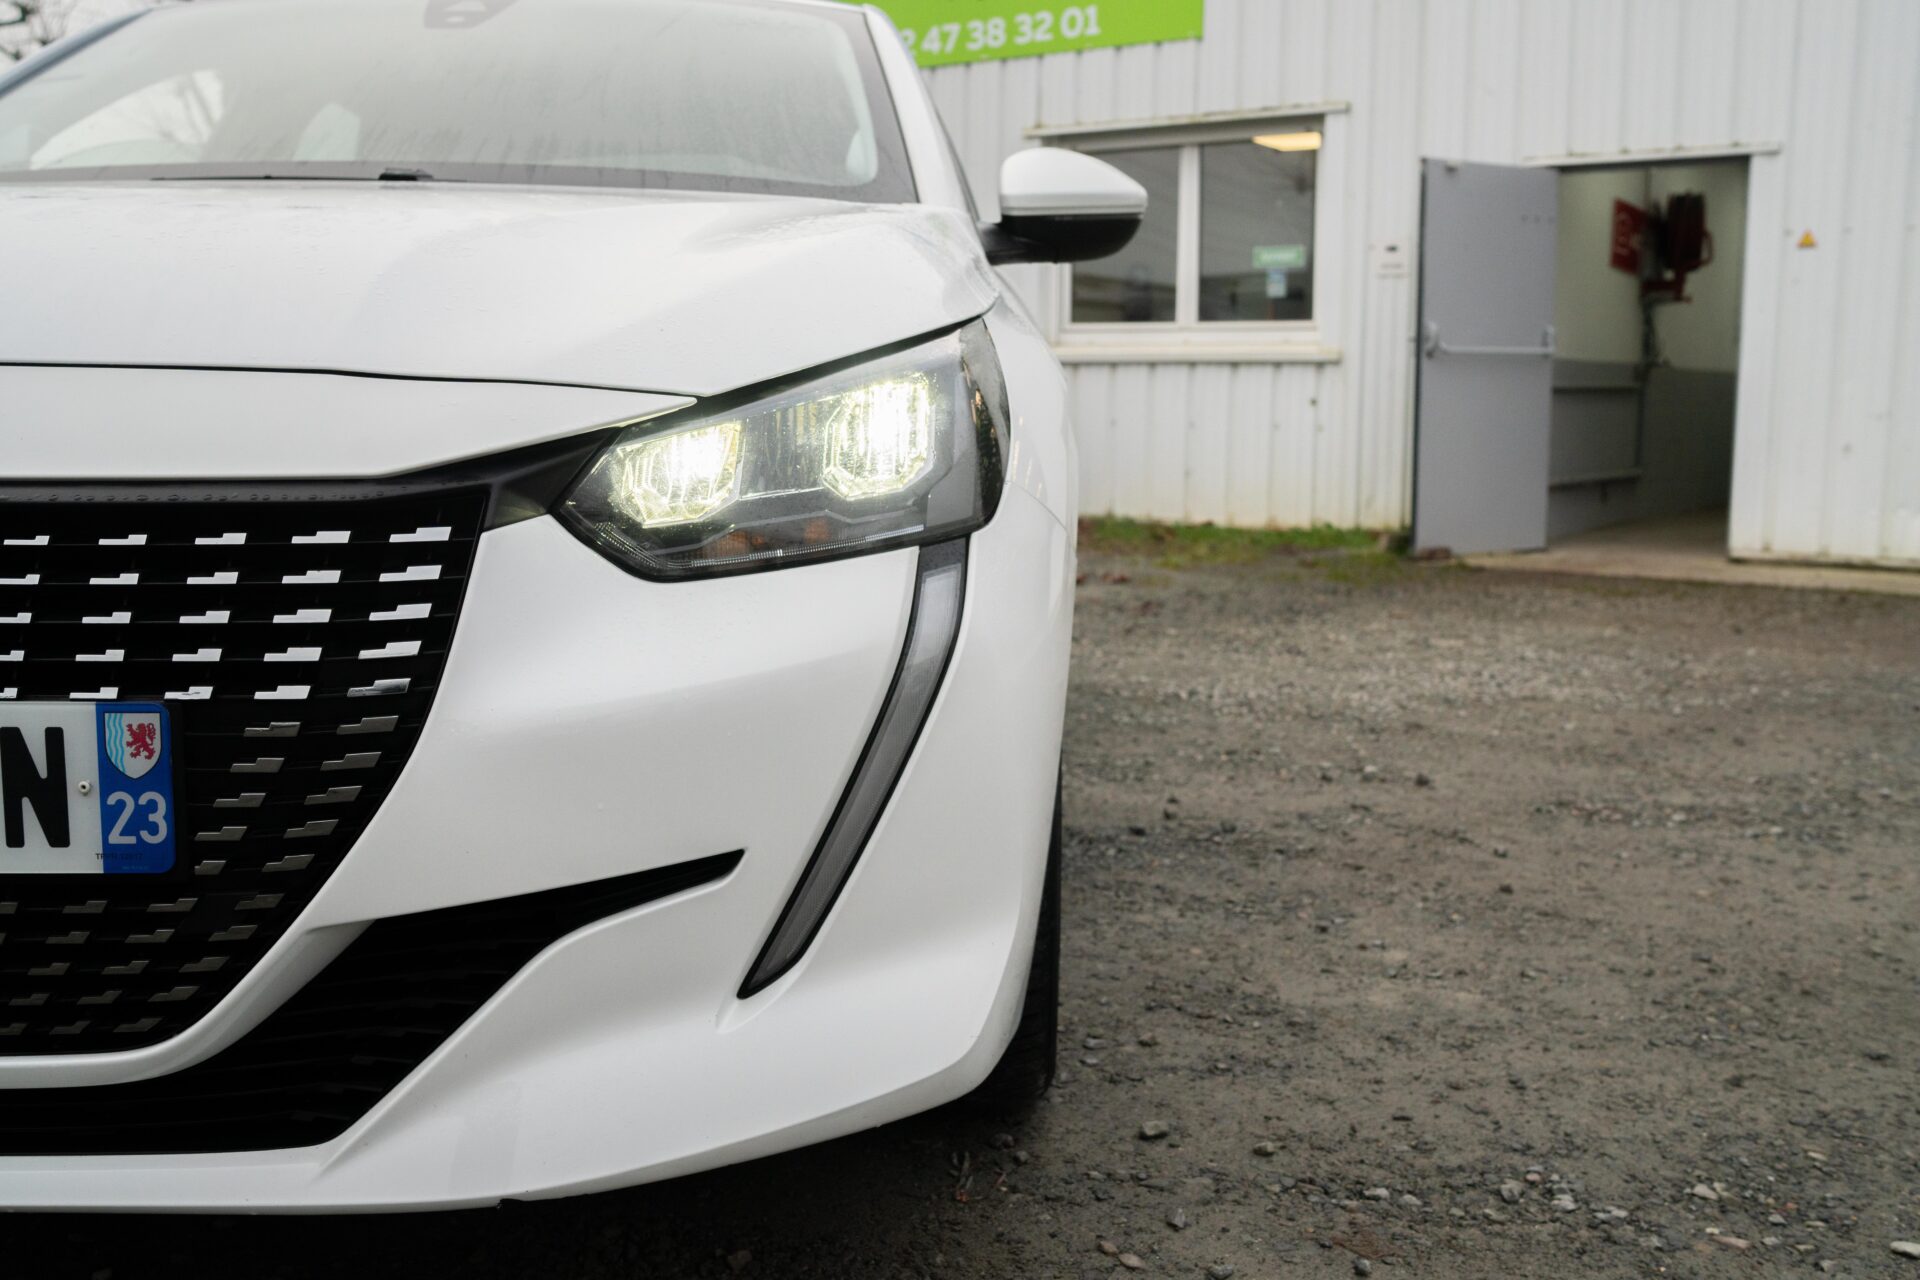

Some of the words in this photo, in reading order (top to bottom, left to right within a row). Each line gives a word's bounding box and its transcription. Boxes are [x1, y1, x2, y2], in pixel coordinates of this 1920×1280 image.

[920, 23, 961, 54] 47
[966, 17, 1006, 50] 38
[1013, 11, 1054, 44] 32
[1060, 5, 1101, 38] 01
[0, 727, 70, 848] N
[106, 791, 168, 844] 23
